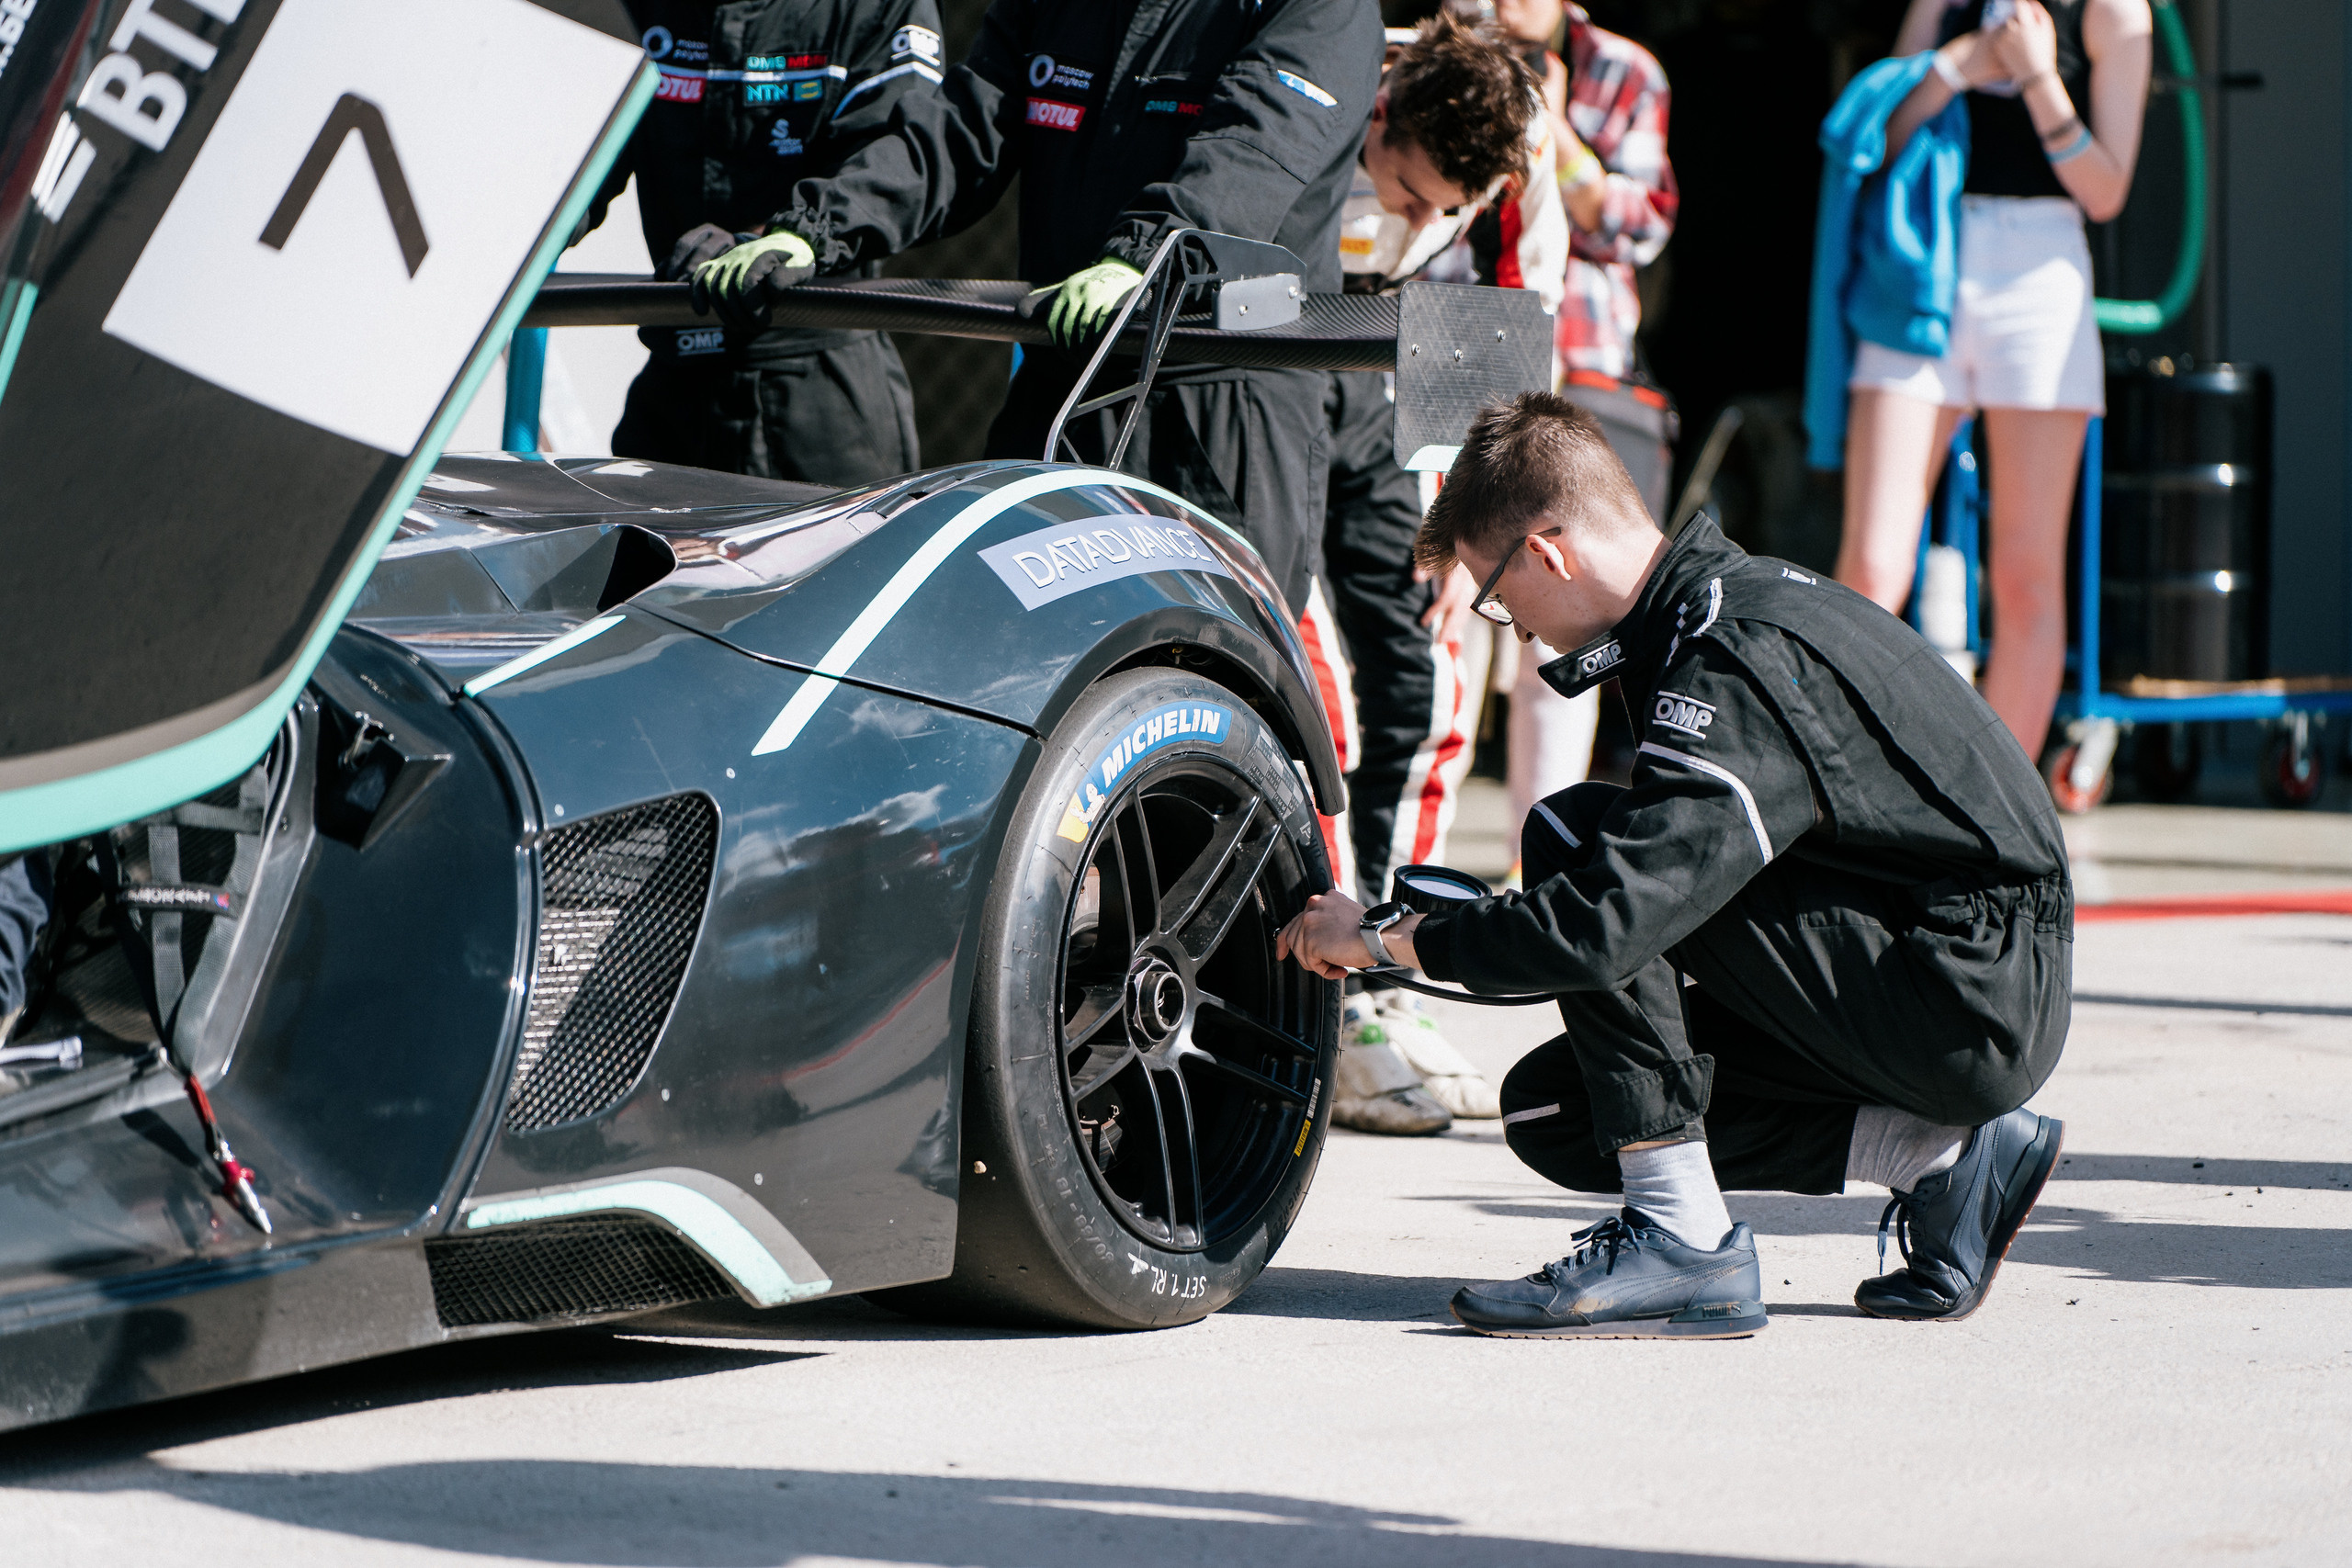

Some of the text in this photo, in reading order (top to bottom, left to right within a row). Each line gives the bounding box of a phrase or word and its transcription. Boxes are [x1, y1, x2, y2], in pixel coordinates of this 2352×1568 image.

[656, 75, 703, 99] OTUL
[745, 83, 789, 102] NTN
[1026, 100, 1080, 128] MOTUL
[676, 332, 724, 349] OMP
[1011, 525, 1212, 589] DATADVANCE
[1581, 643, 1622, 674] OMP
[1655, 697, 1713, 731] OMP
[1102, 707, 1222, 789] MICHELIN
[1150, 1265, 1168, 1295] RL
[1180, 1275, 1207, 1299] SET
